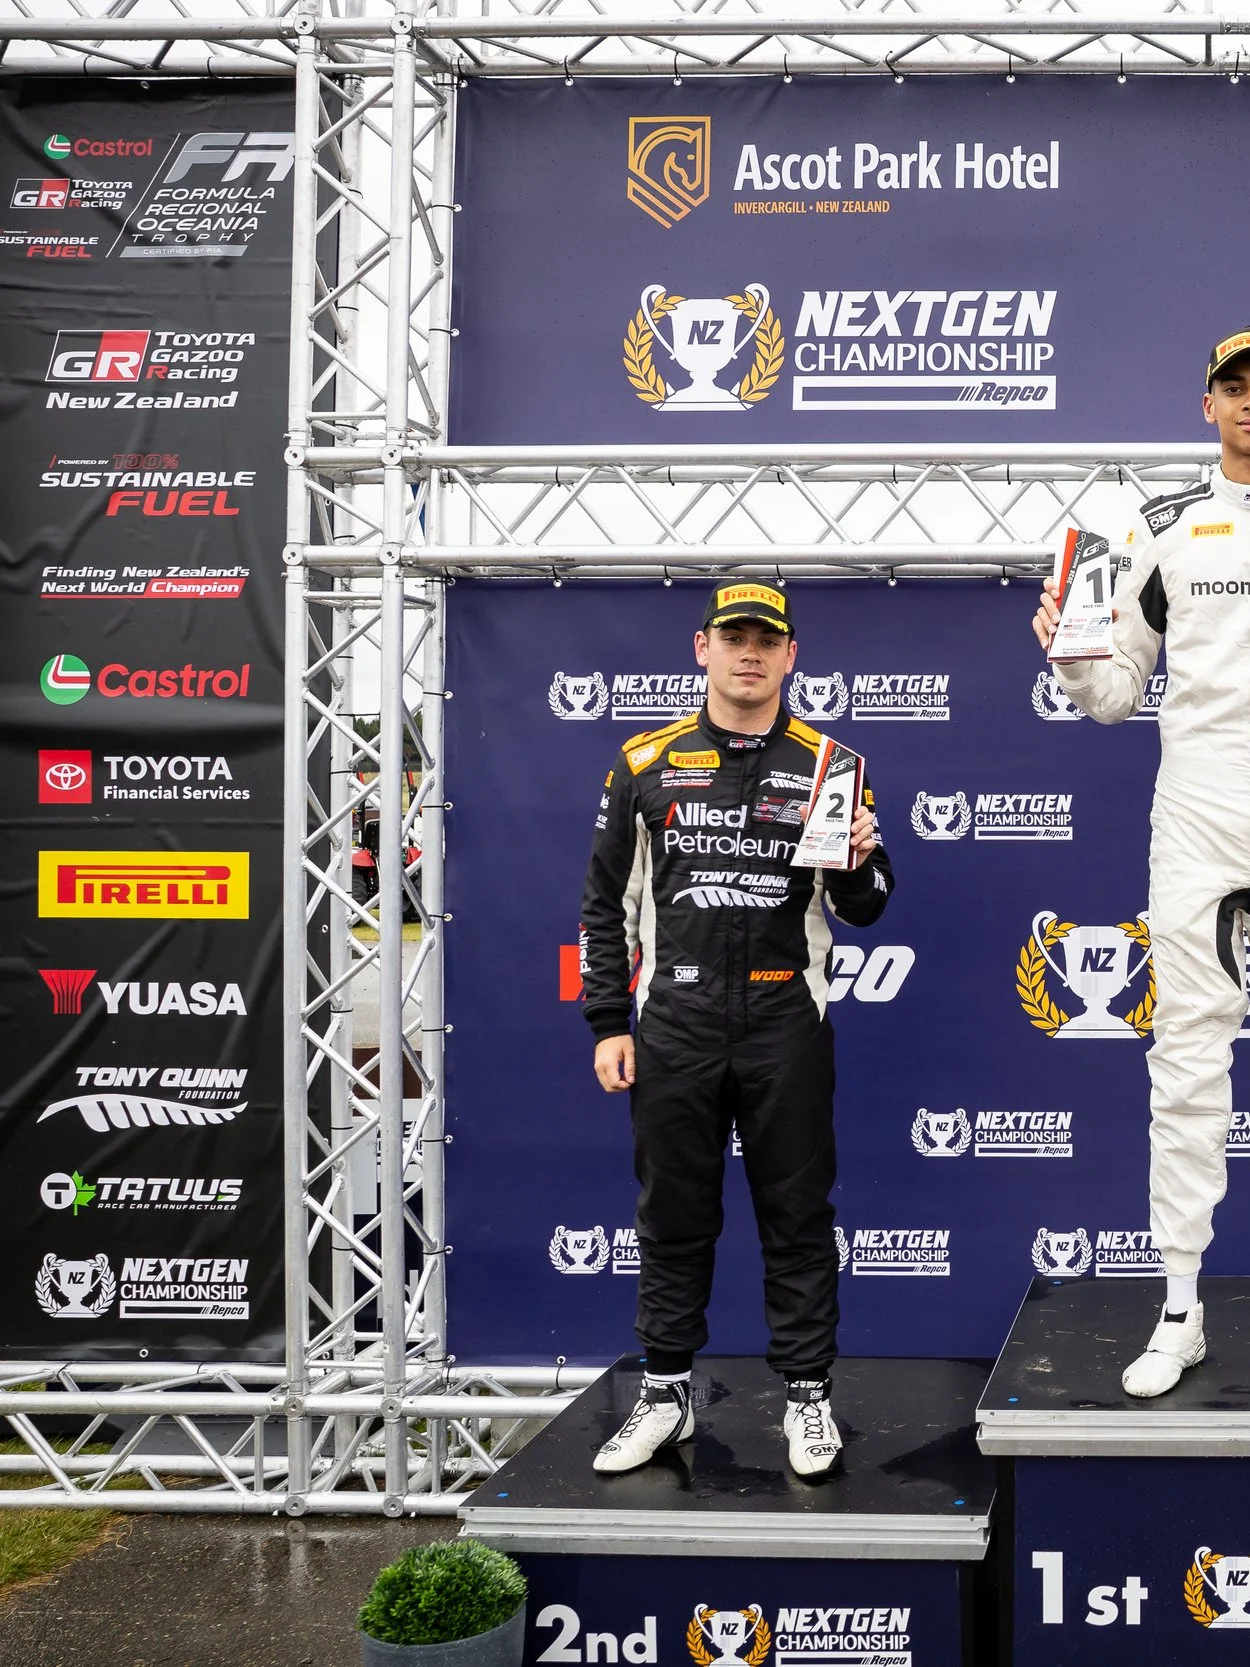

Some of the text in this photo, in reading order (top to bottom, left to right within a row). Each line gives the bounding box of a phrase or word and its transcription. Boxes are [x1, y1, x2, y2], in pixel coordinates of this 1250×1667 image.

[71, 138, 153, 156] Castrol
[733, 141, 1059, 190] Ascot Park Hotel
[14, 191, 65, 206] GR
[154, 188, 275, 199] FORMULA
[68, 199, 123, 209] Racing
[144, 202, 267, 215] REGIONAL
[734, 201, 890, 214] INVERCARGILL NEW ZEALAND
[136, 217, 259, 231] OCEANIA
[27, 246, 92, 257] FUEL
[794, 291, 1057, 337] NEXTGEN
[687, 320, 724, 345] NZ
[52, 352, 141, 378] GR
[794, 342, 1054, 371] CHAMPIONSHIP
[146, 365, 238, 382] Racing
[46, 391, 238, 408] New Zealand
[974, 382, 1049, 405] Repco
[113, 454, 179, 469] 100%
[39, 472, 256, 487] SUSTAINABLE
[106, 491, 240, 515] FUEL
[1149, 509, 1176, 527] OMP
[1194, 525, 1230, 535] PIRELLI
[42, 566, 249, 579] Finding New Zealand's
[41, 582, 239, 596] Next World Champion
[1086, 568, 1103, 603] 1
[724, 587, 779, 605] PIRELLI
[97, 664, 250, 697] Castrol
[852, 675, 950, 692] NEXTGEN
[813, 685, 825, 696] NZ
[852, 695, 949, 706] CHAMPIONSHIP
[104, 756, 233, 780] TOYOTA
[675, 755, 715, 764] PIRELLI
[104, 786, 250, 800] Financial Services
[826, 793, 844, 818] 2
[975, 795, 1072, 812] NEXTGEN
[665, 803, 747, 828] Allied
[974, 814, 1072, 826] CHAMPIONSHIP
[665, 831, 799, 859] Petroleum
[57, 865, 231, 904] PIRELLI
[690, 871, 789, 888] TONY QUINN
[1080, 947, 1117, 972] NZ
[675, 969, 698, 980] OMP
[749, 970, 794, 980] WOOD
[98, 982, 247, 1015] YUASA
[76, 1067, 247, 1088] TONY QUINN
[180, 1090, 240, 1099] FOUNDATION
[97, 1178, 243, 1201] TATUUS
[67, 1272, 85, 1284] NZ
[121, 1258, 248, 1282] NEXTGEN
[121, 1284, 248, 1299] CHAMPIONSHIP
[209, 1304, 245, 1316] Repco
[1032, 1551, 1148, 1625] 1 st
[775, 1608, 911, 1632] NEXTGEN
[535, 1604, 657, 1663] 2nd
[776, 1635, 910, 1650] CHAMPIONSHIP
